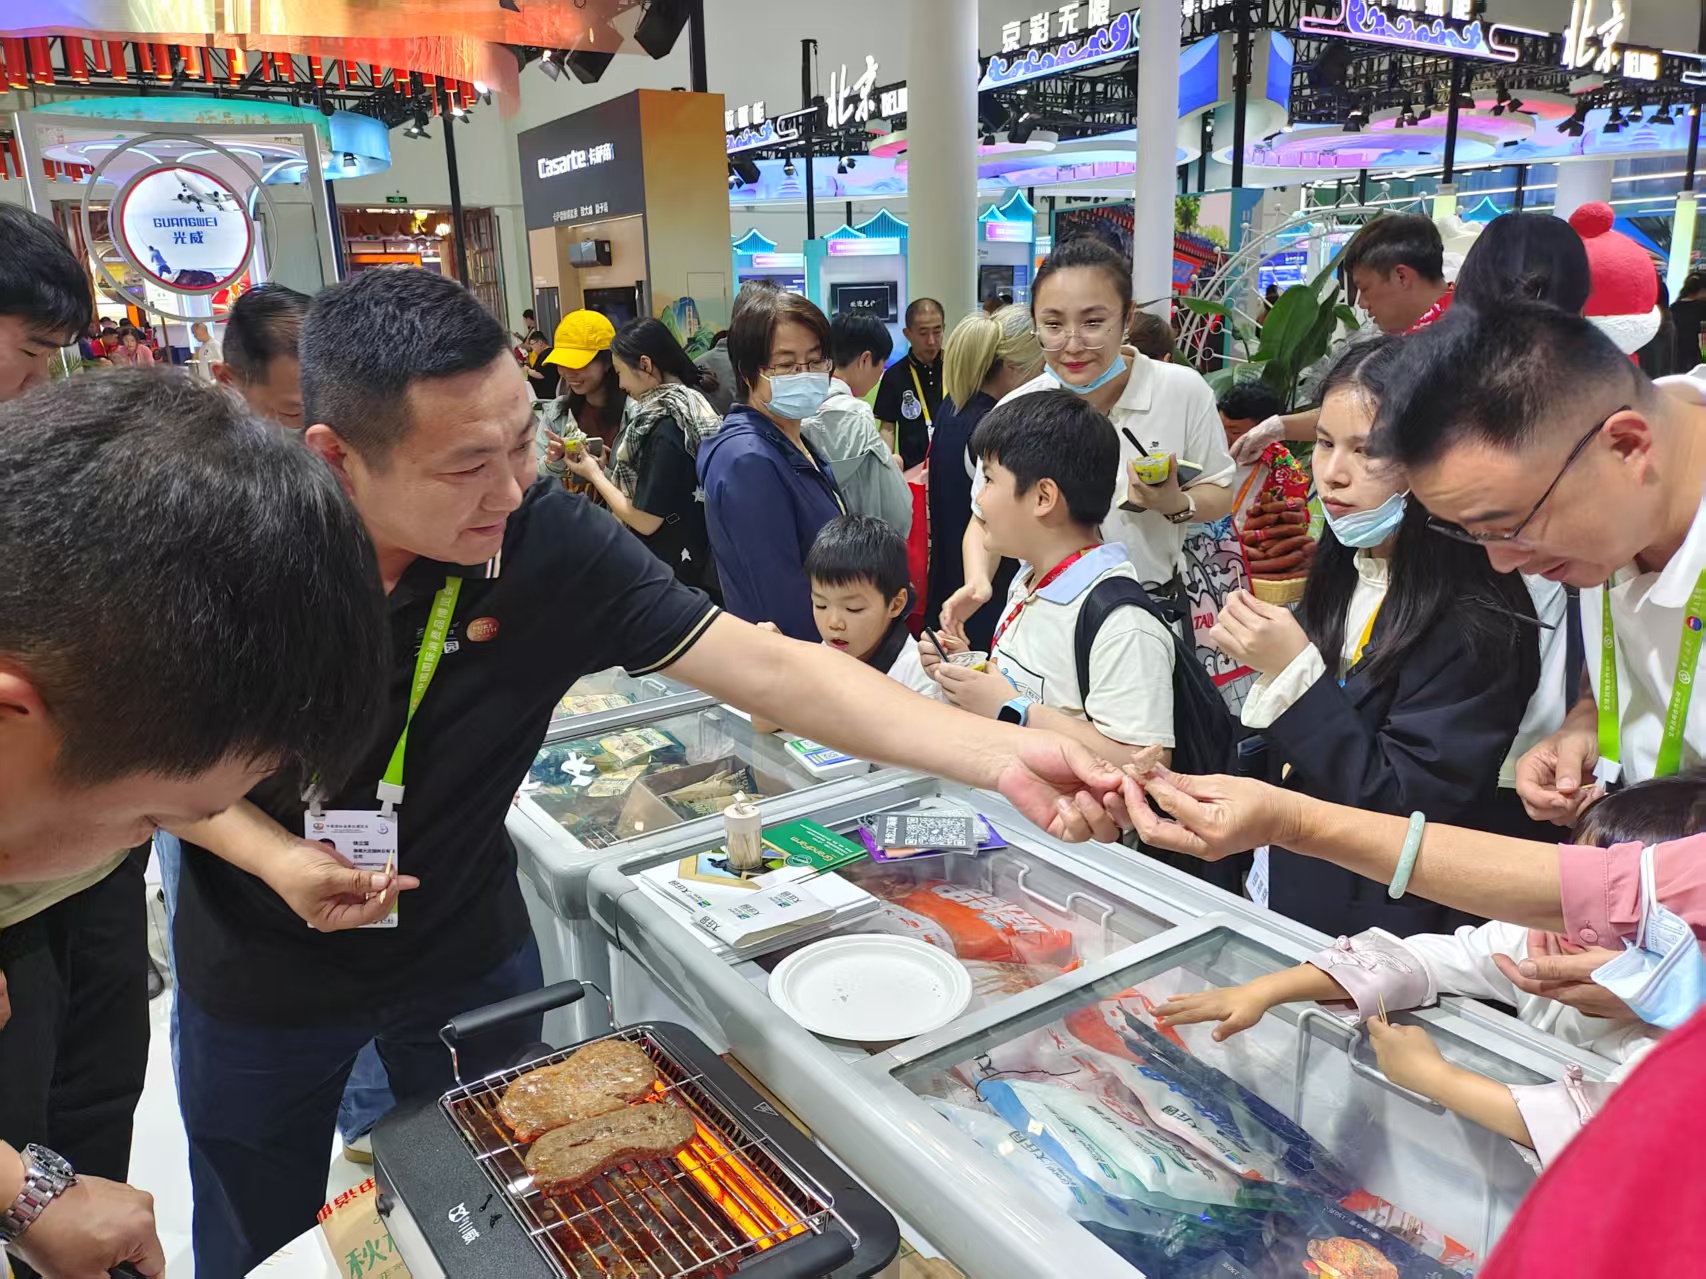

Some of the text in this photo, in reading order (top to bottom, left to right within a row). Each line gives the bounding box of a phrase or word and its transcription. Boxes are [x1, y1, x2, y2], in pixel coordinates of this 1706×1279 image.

[1001, 0, 1111, 53] 京彩无限
[827, 55, 878, 129] 北京
[537, 149, 587, 179] Casarte
[153, 216, 218, 229] GUANGWEI
[173, 231, 204, 245] 光威
[699, 915, 723, 932] 大庄园
[345, 1233, 394, 1279] 秋
